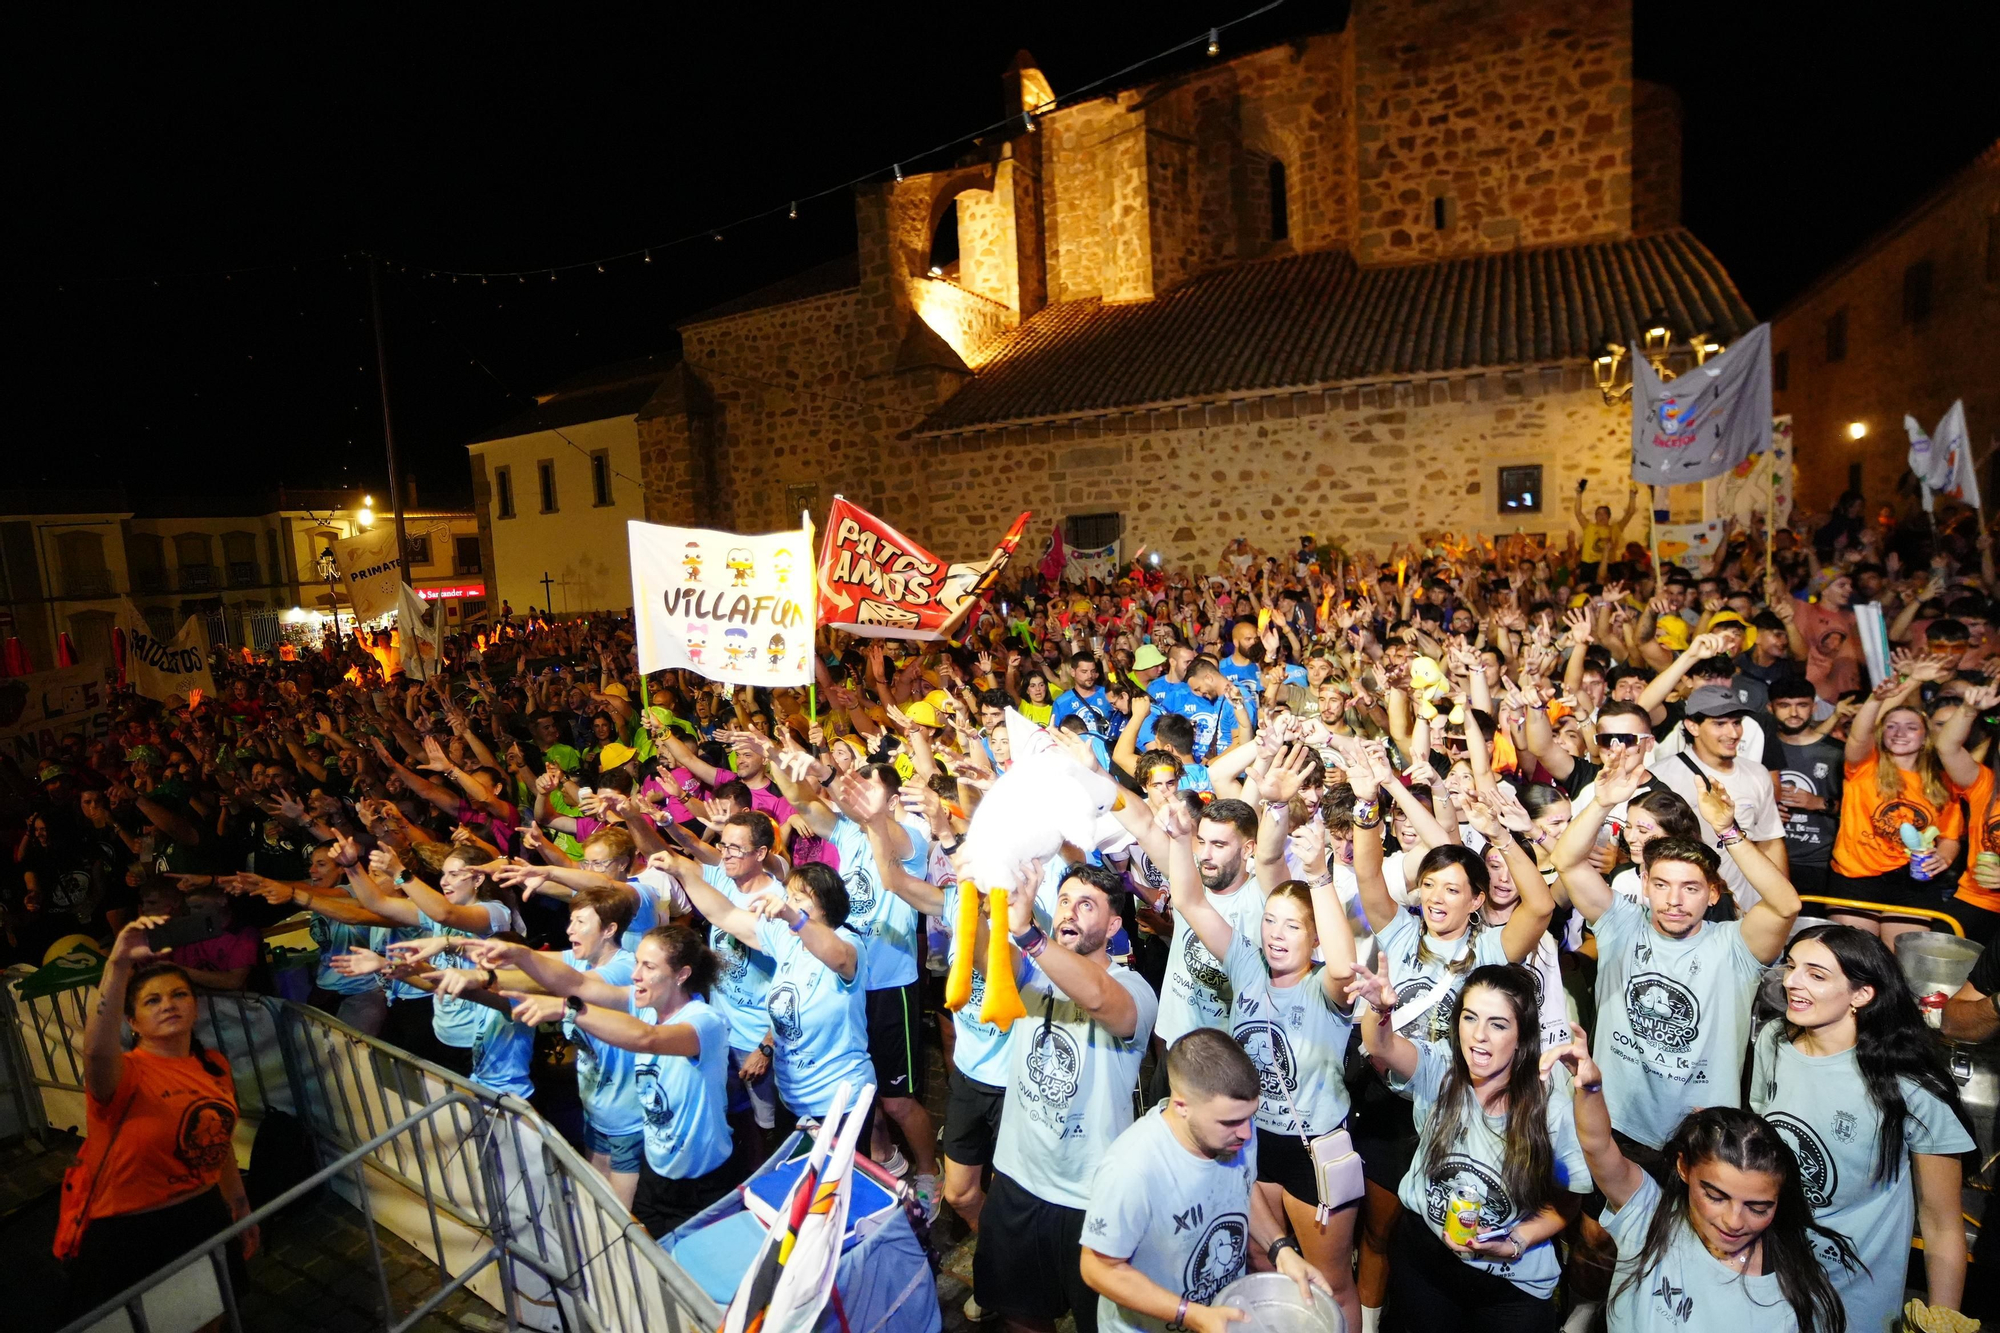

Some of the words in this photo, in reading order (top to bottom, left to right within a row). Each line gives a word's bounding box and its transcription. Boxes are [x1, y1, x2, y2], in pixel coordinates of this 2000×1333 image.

[832, 549, 933, 605] AMOS
[427, 588, 463, 598] Sanander
[1655, 1020, 1694, 1038] JUEGO
[1653, 1032, 1684, 1047] OCA
[1259, 1070, 1296, 1087] JUEO
[1173, 1203, 1204, 1235] XII
[1819, 1253, 1842, 1264] INPRO
[1189, 1280, 1217, 1302] GRAN
